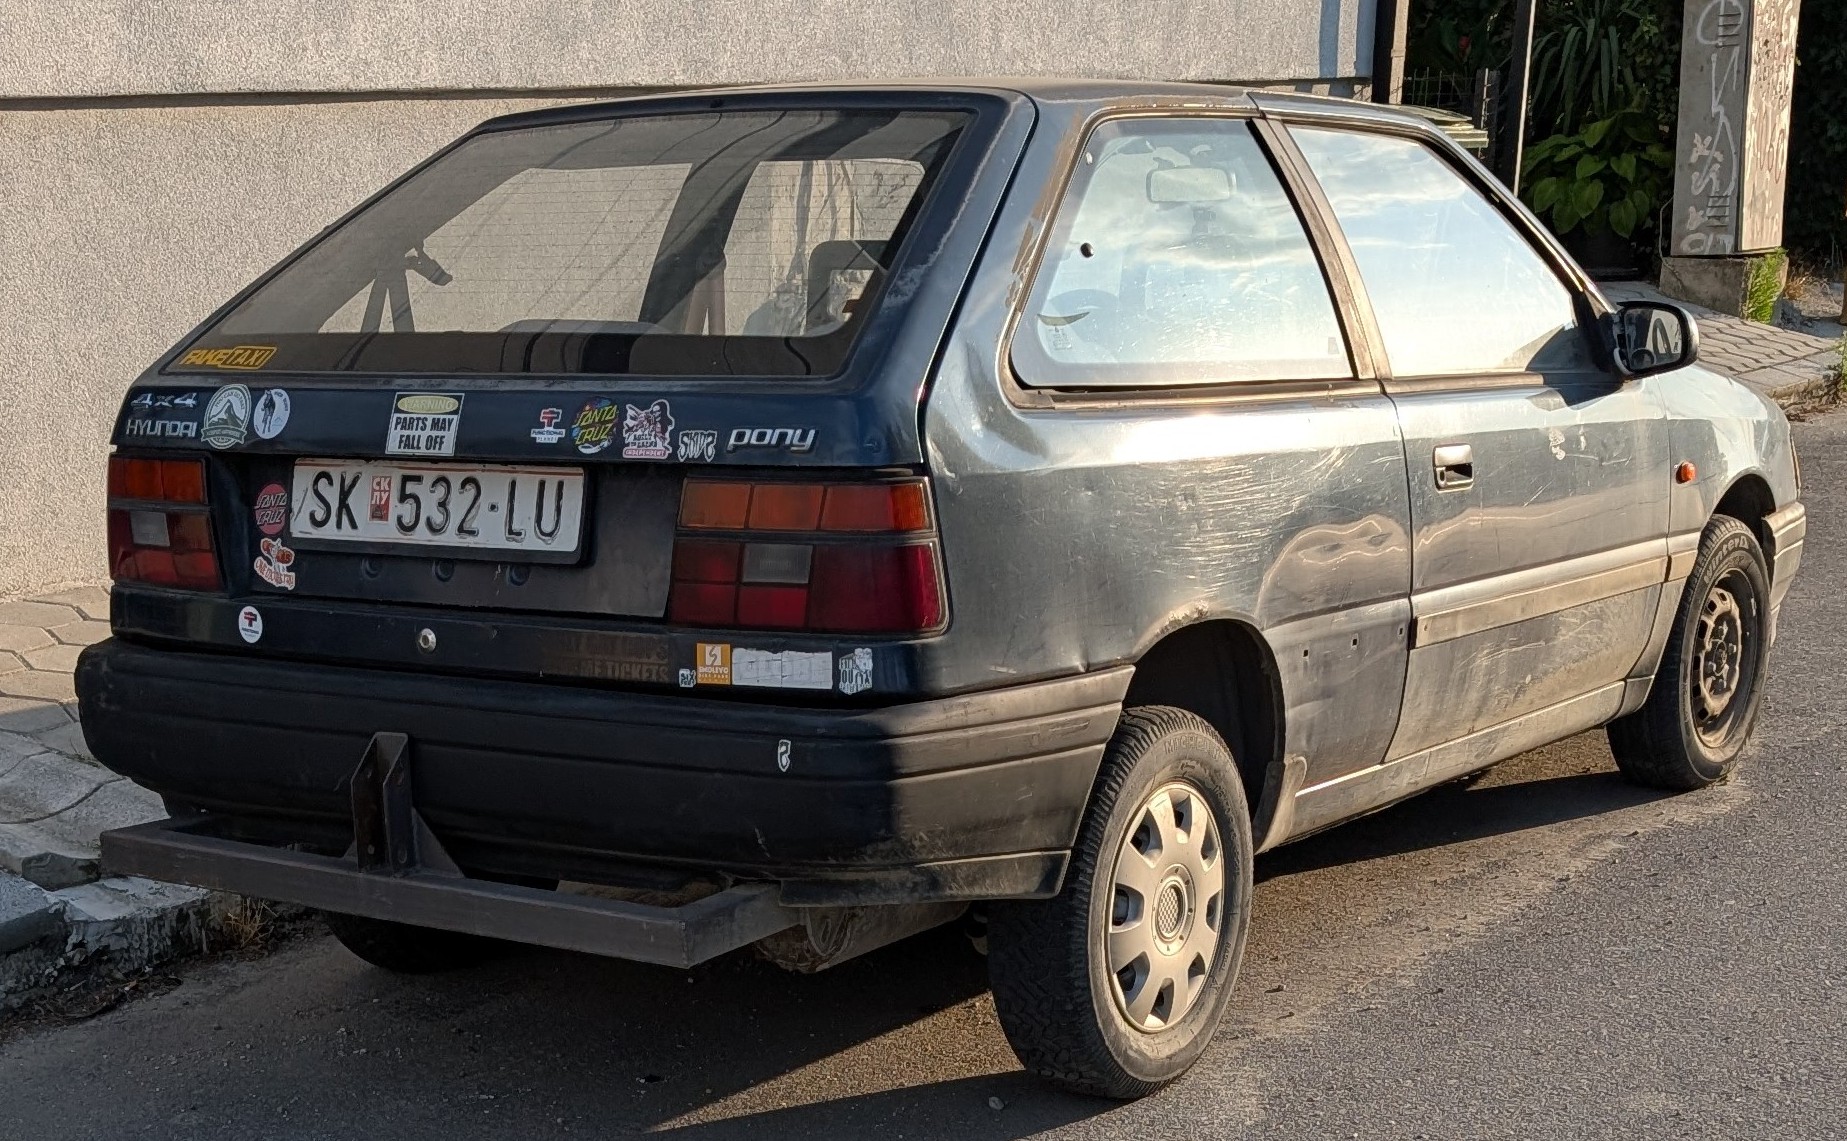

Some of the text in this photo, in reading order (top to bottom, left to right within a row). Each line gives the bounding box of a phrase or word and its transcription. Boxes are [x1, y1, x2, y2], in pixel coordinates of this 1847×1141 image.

[404, 398, 454, 410] WARNING
[575, 403, 618, 426] SANTA
[126, 419, 198, 439] HYUNDAI
[394, 416, 454, 432] PARTS MAY
[398, 434, 445, 451] FALL OFF
[575, 423, 613, 445] CRUZ
[254, 493, 287, 509] SANTA
[309, 470, 363, 530] SK
[257, 508, 286, 525] CRUZ
[606, 661, 669, 684] TICKETS
